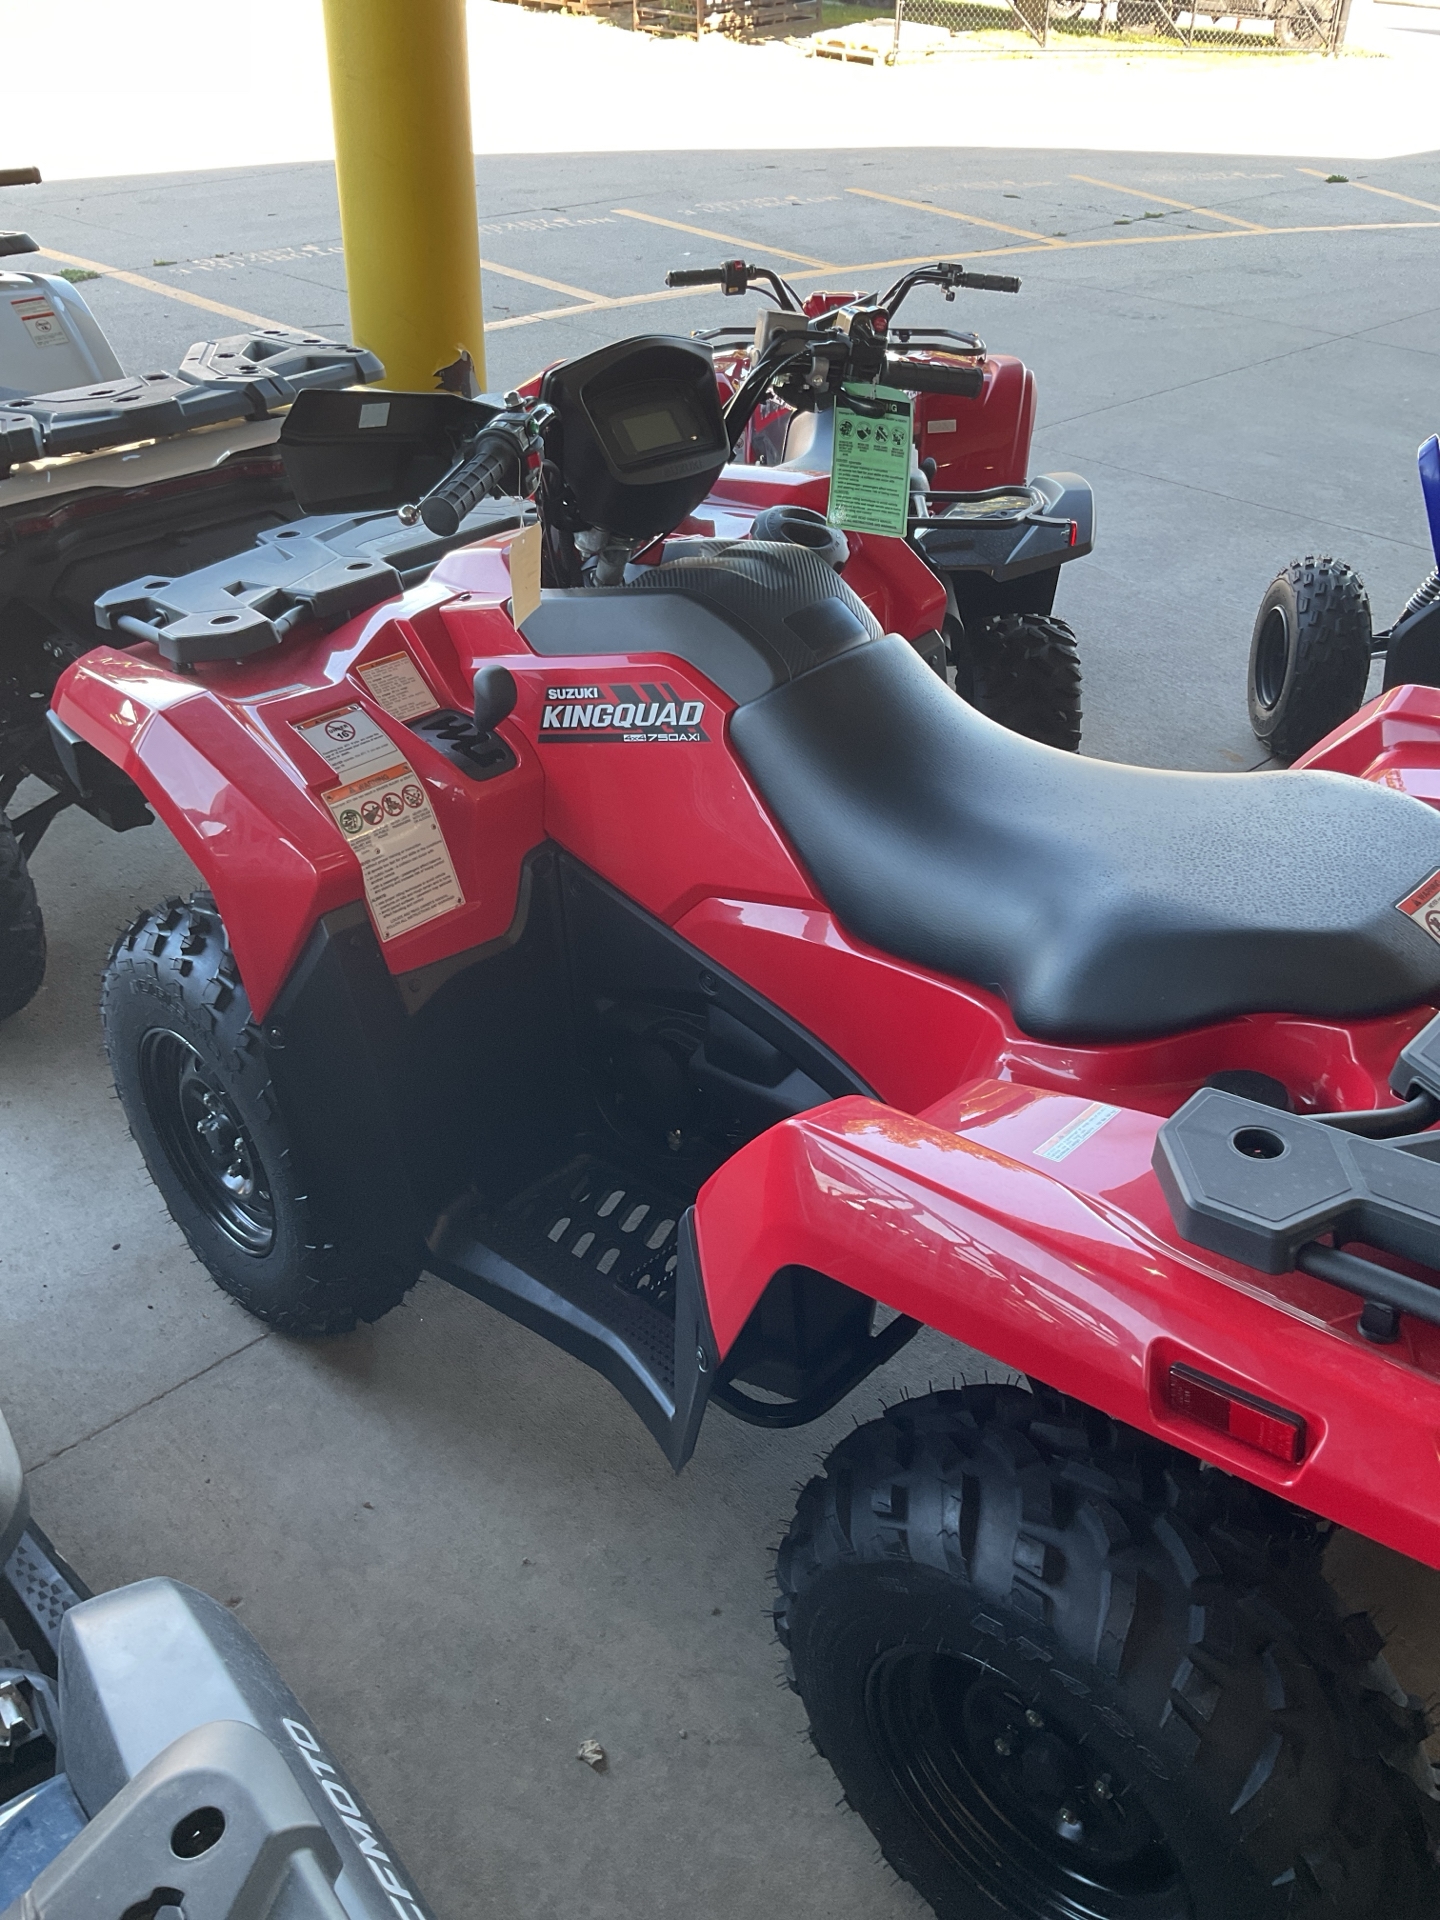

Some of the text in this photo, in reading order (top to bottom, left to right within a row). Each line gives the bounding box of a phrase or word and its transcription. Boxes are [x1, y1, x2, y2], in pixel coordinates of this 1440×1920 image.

[548, 687, 598, 700] SUZUKI
[542, 702, 704, 728] KINGQUAD
[337, 731, 350, 739] 16
